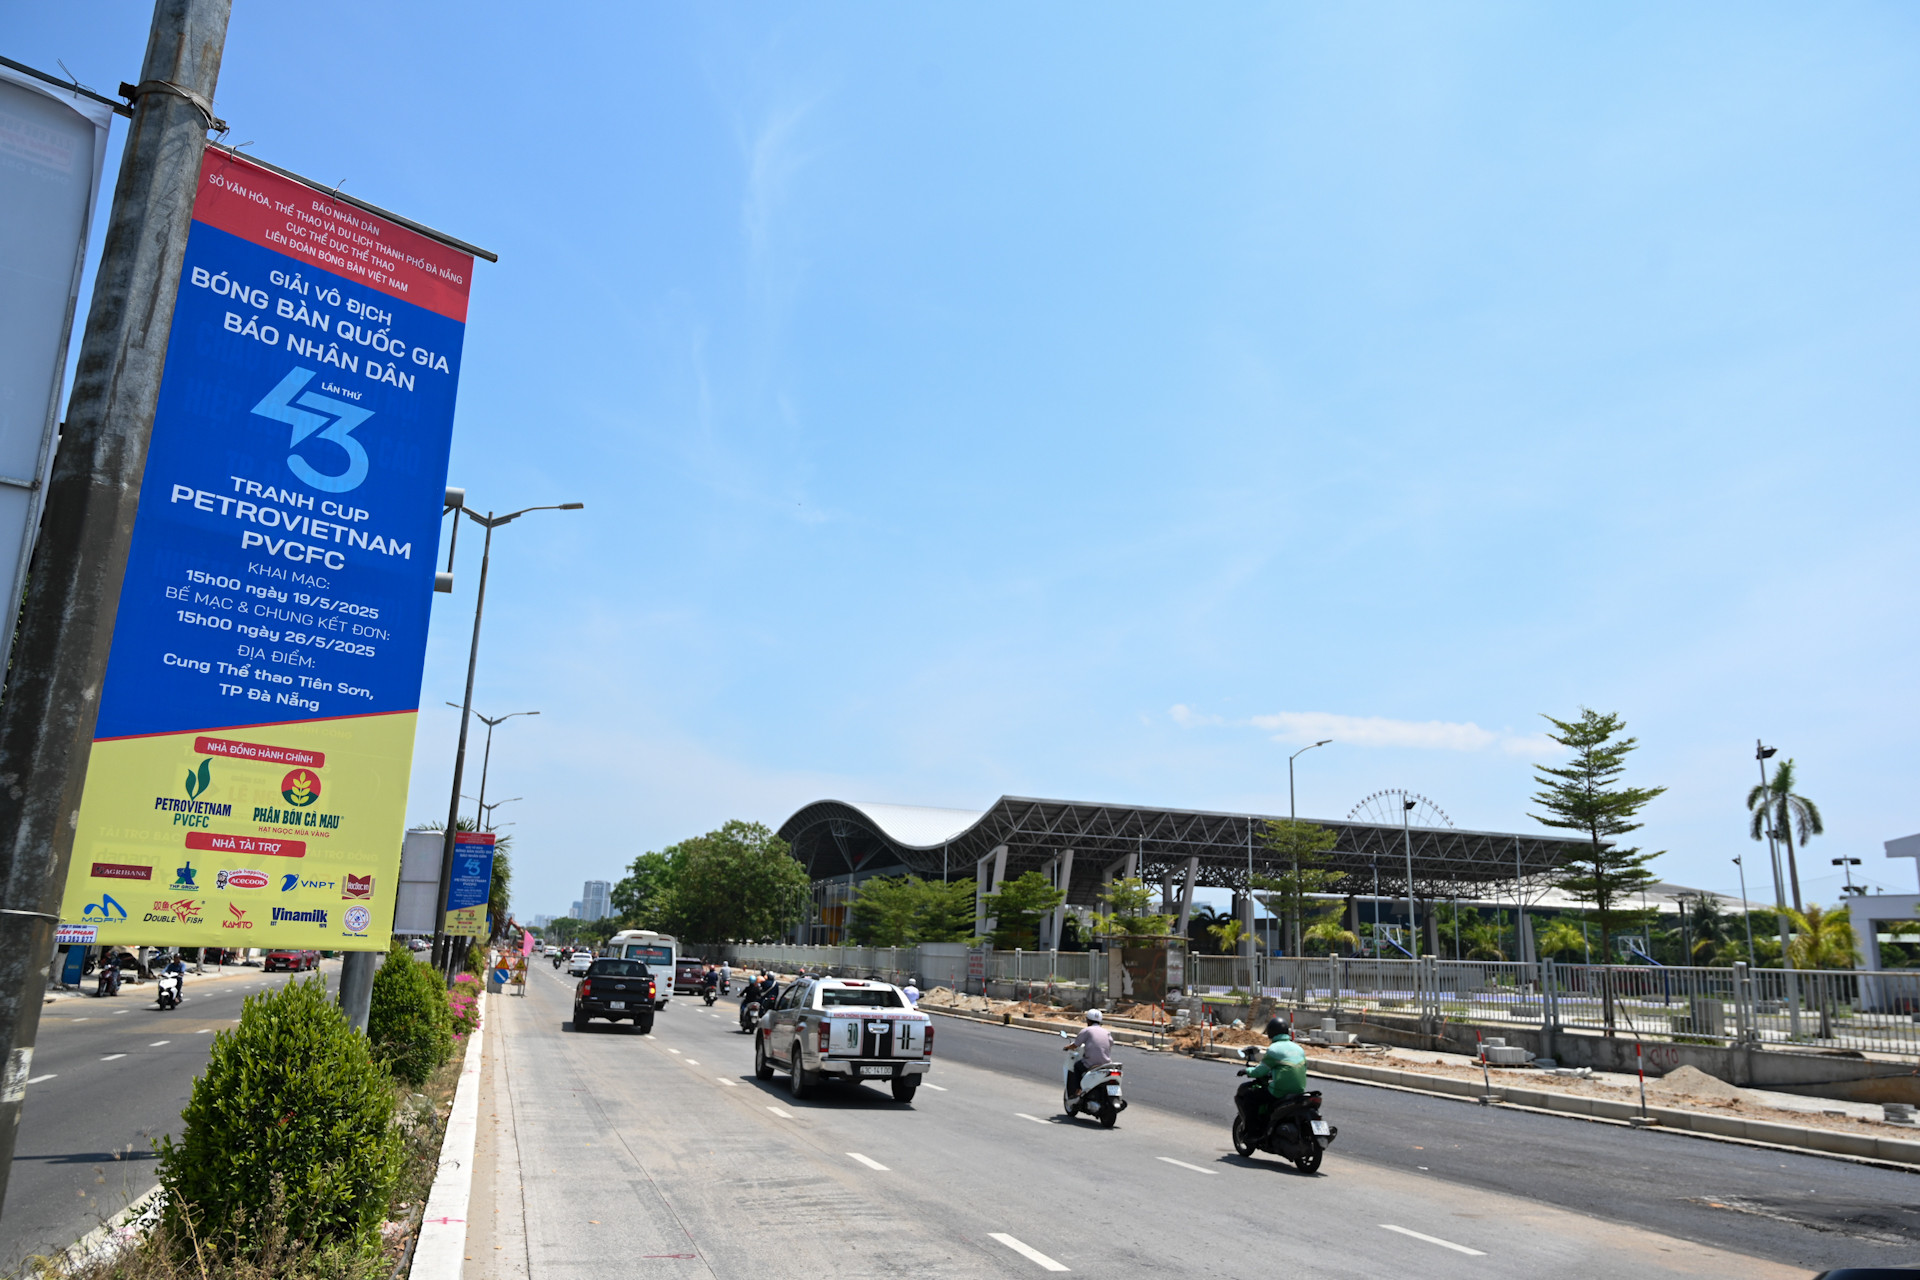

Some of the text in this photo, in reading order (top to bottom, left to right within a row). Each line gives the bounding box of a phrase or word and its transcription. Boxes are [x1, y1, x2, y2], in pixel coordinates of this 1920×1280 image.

[208, 173, 463, 286] SỞ VĂN HÓA, THỂ THAO VÀ DU LỊCH THÀNH PHỐ ĐÀ NẴNG
[311, 200, 380, 236] BÁO NHÂN DÂN
[265, 229, 408, 293] LIÊN ĐOÀN BÓNG BÀN VIỆT NAM
[285, 221, 395, 272] CỤC THỂ DỤC THỂ THAO
[269, 270, 392, 326] GIẢI VÔ ĐỊCH
[190, 266, 451, 374] BÓNG BÀN QUỐC GIA
[223, 311, 416, 392] BÁO NHÂN DÂN
[341, 388, 362, 401] THỨ
[250, 366, 376, 493] 43
[230, 476, 370, 523] TRANH CUP
[170, 484, 412, 560] PETROVIETNAM
[241, 530, 346, 570] PVCFC
[248, 561, 330, 590] KHAI MẠC:
[186, 569, 379, 620] 15h00 ngày 19/5/2025
[165, 585, 391, 641] BẾ MẠC & CHUNG KẾT ĐƠN:
[176, 609, 376, 658] 15h00 ngày 26/5/2025
[237, 644, 316, 669] ĐỊA ĐIỂM:
[163, 653, 374, 700] Cung Thể thao Tiên Sơn,
[219, 683, 320, 713] TP Đà Nẵng
[207, 742, 228, 754] NHÀ
[229, 743, 256, 757] ĐỒNG
[258, 746, 284, 761] HÀNH
[285, 750, 313, 764] CHÍNH
[155, 797, 232, 817] PETROVIETNAM
[173, 813, 210, 828] PVCFC
[253, 806, 340, 829] PHÂN BÓN CÀ MAU
[212, 836, 282, 854] NHÀ TÀI TRỢ
[258, 826, 330, 838] HẠT NGỌC MÙA VÀNG
[104, 868, 147, 877] AGRIBANK
[300, 879, 336, 890] VNPT
[186, 916, 204, 924] FISH
[222, 920, 253, 929] KAMITO
[272, 907, 328, 923] Vinamilk
